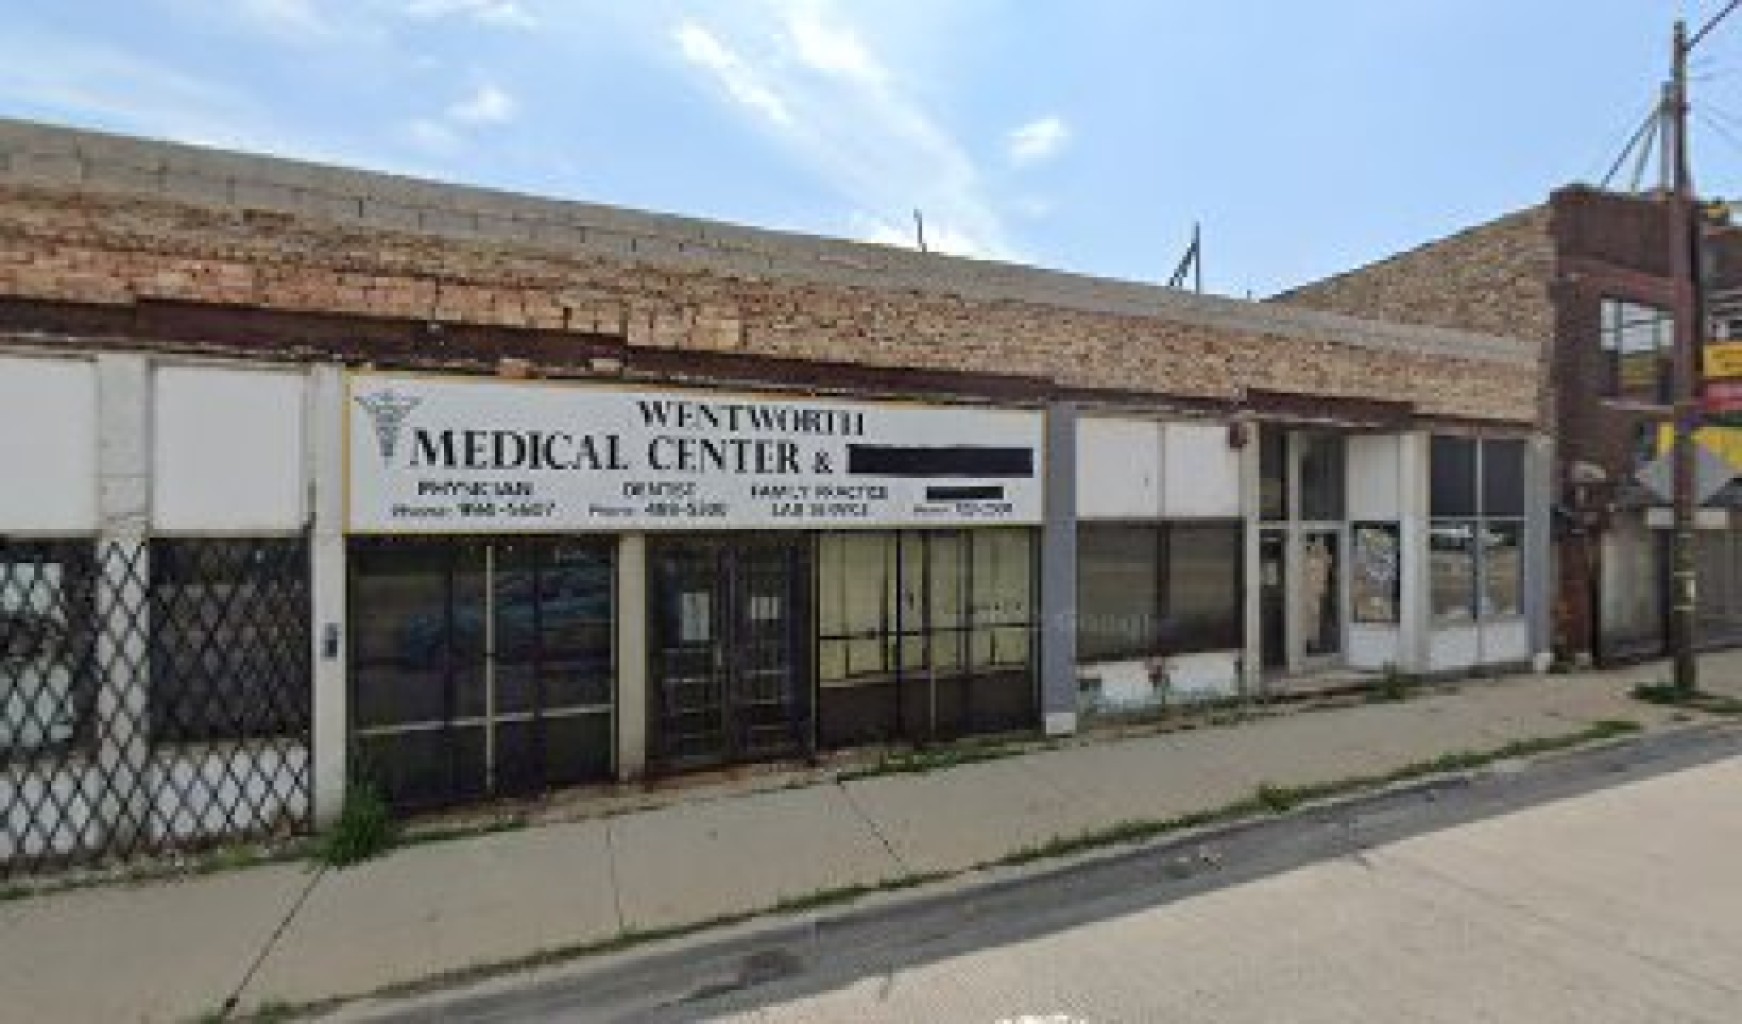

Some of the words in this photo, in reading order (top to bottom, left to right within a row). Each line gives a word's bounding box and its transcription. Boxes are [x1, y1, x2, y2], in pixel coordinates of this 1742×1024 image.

[637, 400, 866, 436] WENTWORTH
[410, 429, 628, 472] MEDICAL
[647, 435, 802, 476] CENTER
[814, 450, 834, 475] &
[417, 482, 534, 496] PHYSICIAN
